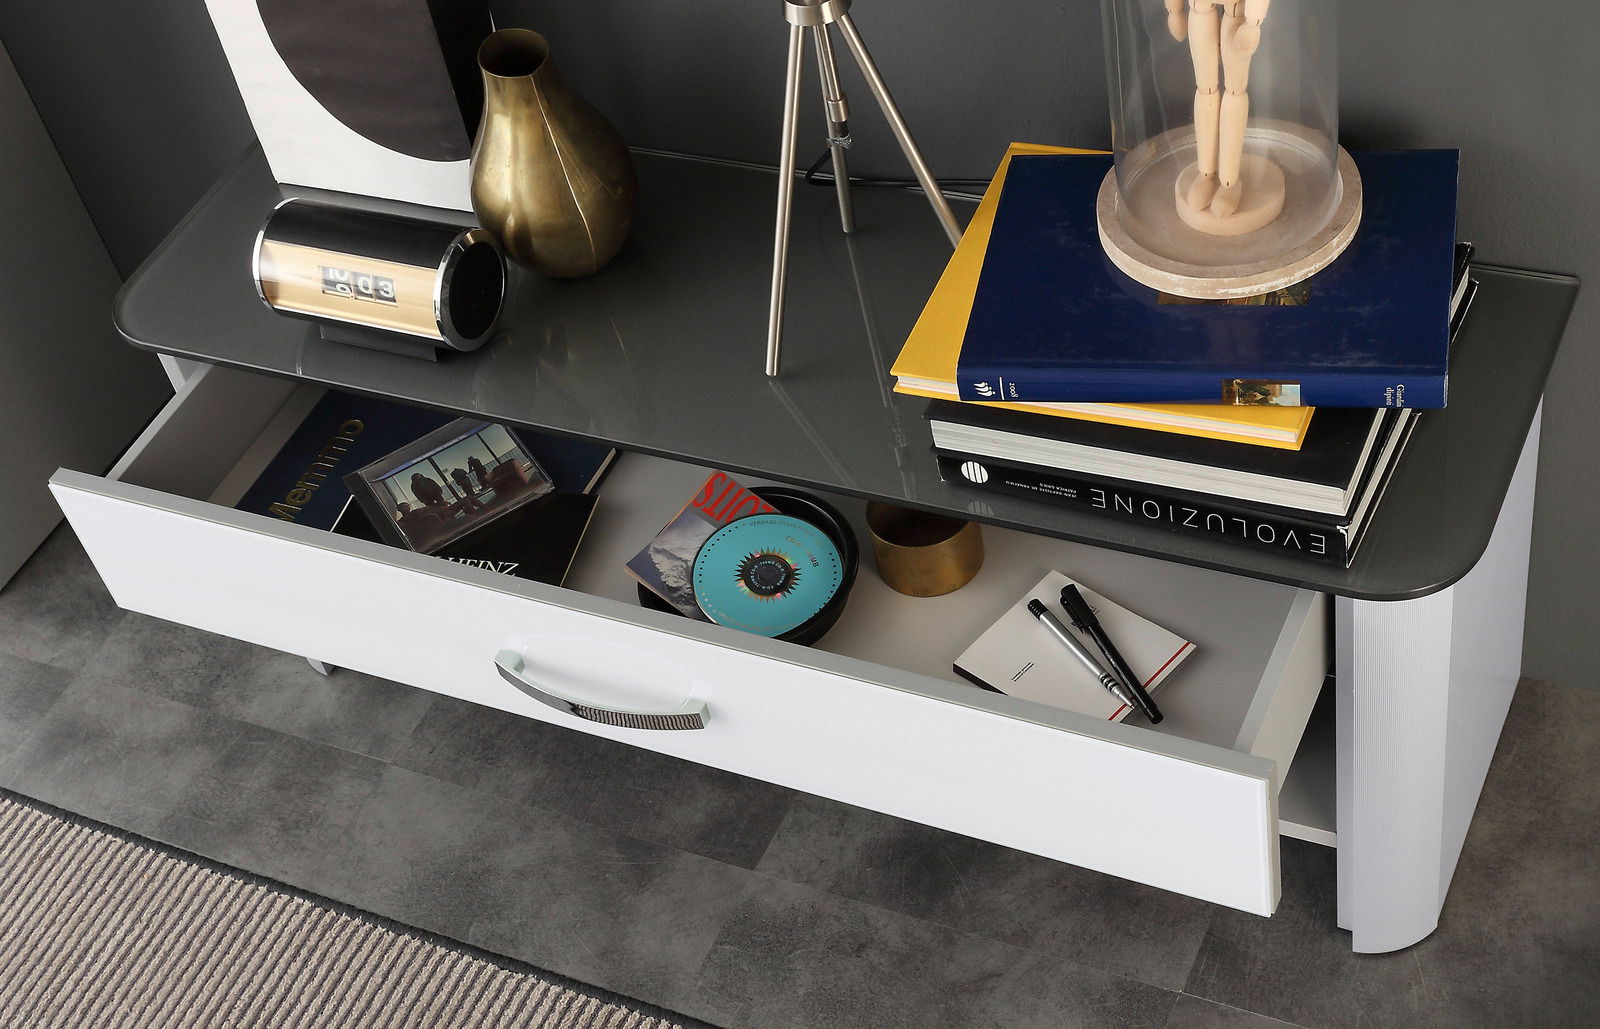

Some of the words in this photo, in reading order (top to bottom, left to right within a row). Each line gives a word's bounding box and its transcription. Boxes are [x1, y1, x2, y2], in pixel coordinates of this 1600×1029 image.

[1008, 382, 1019, 398] 2008
[691, 472, 775, 524] UITS
[1091, 488, 1326, 555] EVOLUZIONE
